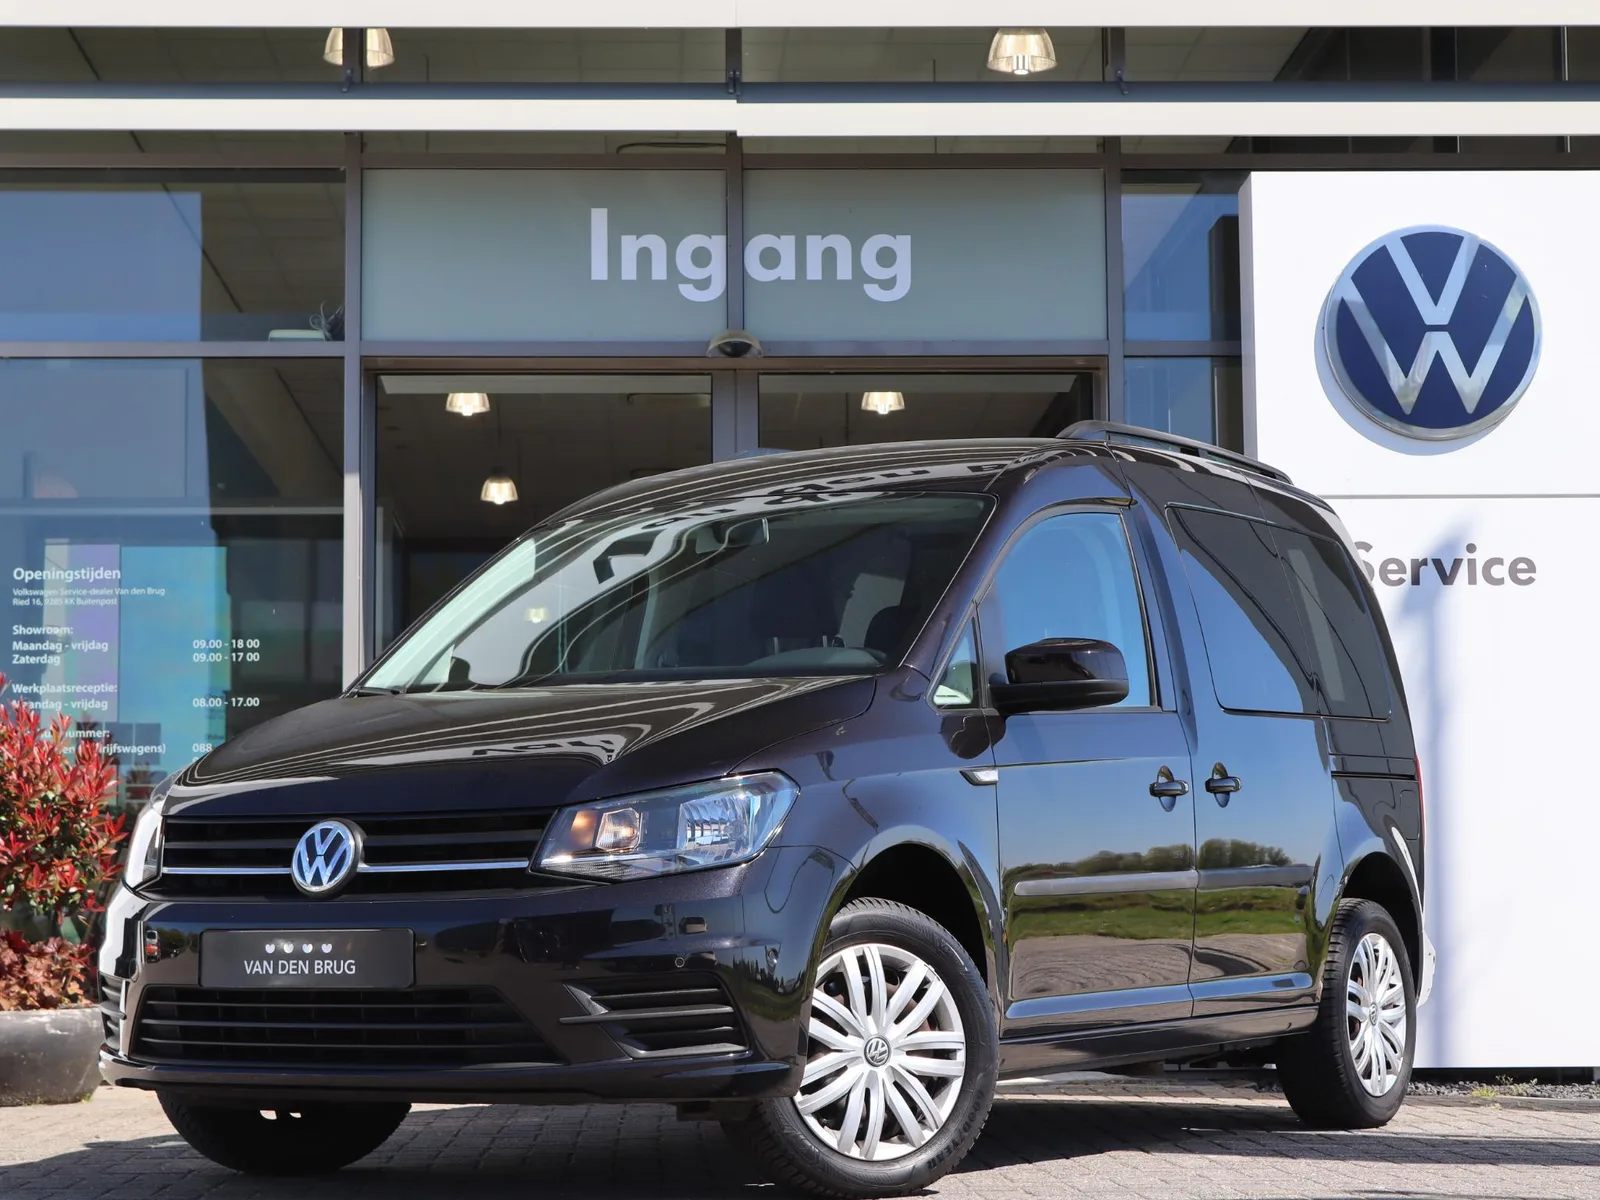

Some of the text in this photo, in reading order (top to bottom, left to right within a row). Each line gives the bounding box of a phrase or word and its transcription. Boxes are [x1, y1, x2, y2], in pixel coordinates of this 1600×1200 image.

[590, 207, 912, 302] Ingang
[1354, 541, 1537, 587] Service
[13, 567, 121, 583] Openingstijden
[12, 586, 166, 598] Volkswagen Service-dealer Van den Brug
[12, 598, 30, 606] Ried
[32, 598, 43, 607] 16,
[77, 597, 118, 606] Buitenpost
[12, 625, 73, 635] Showroom:
[12, 641, 62, 652] Maandag
[71, 640, 109, 652] vrijdag
[192, 639, 222, 649] 09.00
[12, 654, 60, 666] Zaterdag
[192, 652, 222, 662] 09.00
[12, 682, 118, 695] Werkplaatsreceptie:
[70, 698, 108, 711] vrijdag
[192, 697, 222, 707] 08.00
[231, 697, 260, 707] 17.00
[244, 959, 356, 975] VAN DEN BRUG
